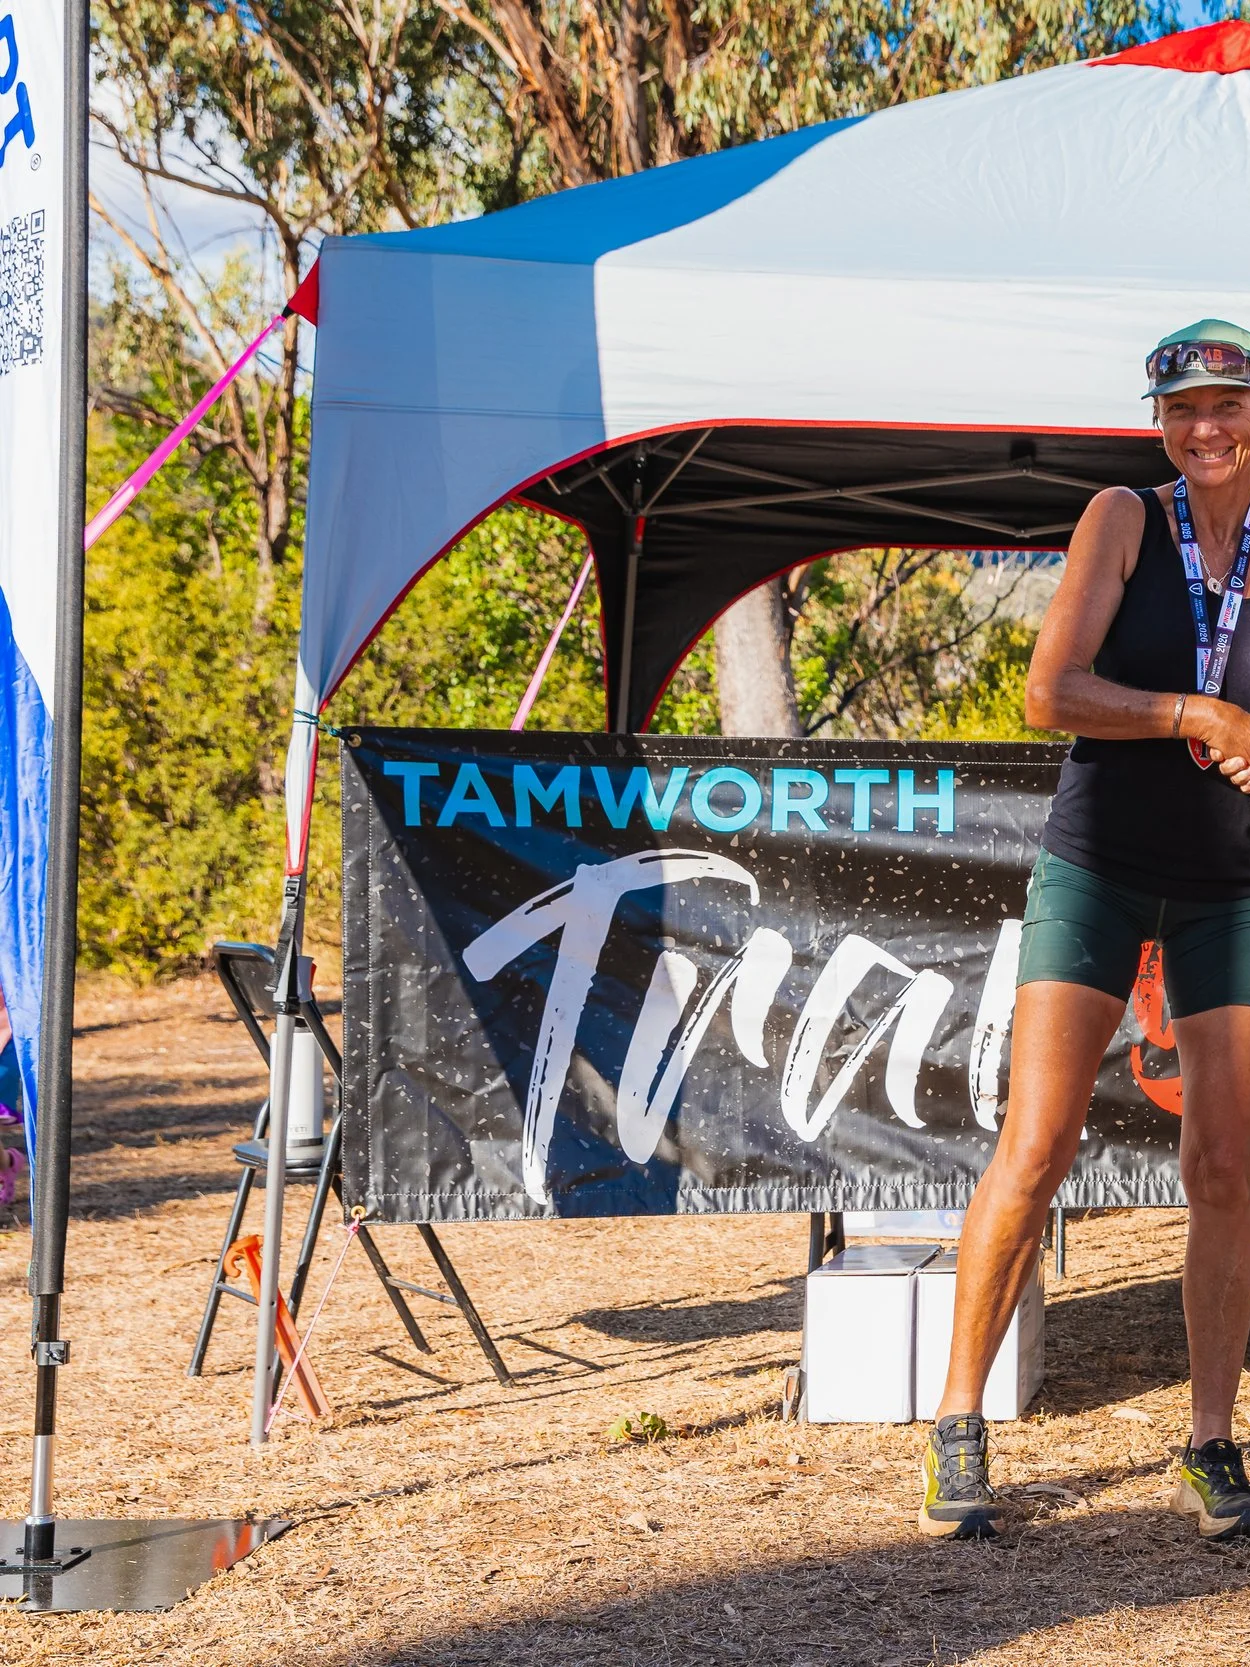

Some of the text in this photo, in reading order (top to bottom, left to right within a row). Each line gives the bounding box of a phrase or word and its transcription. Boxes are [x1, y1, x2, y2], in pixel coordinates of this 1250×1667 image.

[1198, 622, 1208, 643] 2026
[1216, 633, 1228, 653] 2026
[382, 761, 957, 834] TAMWORTH
